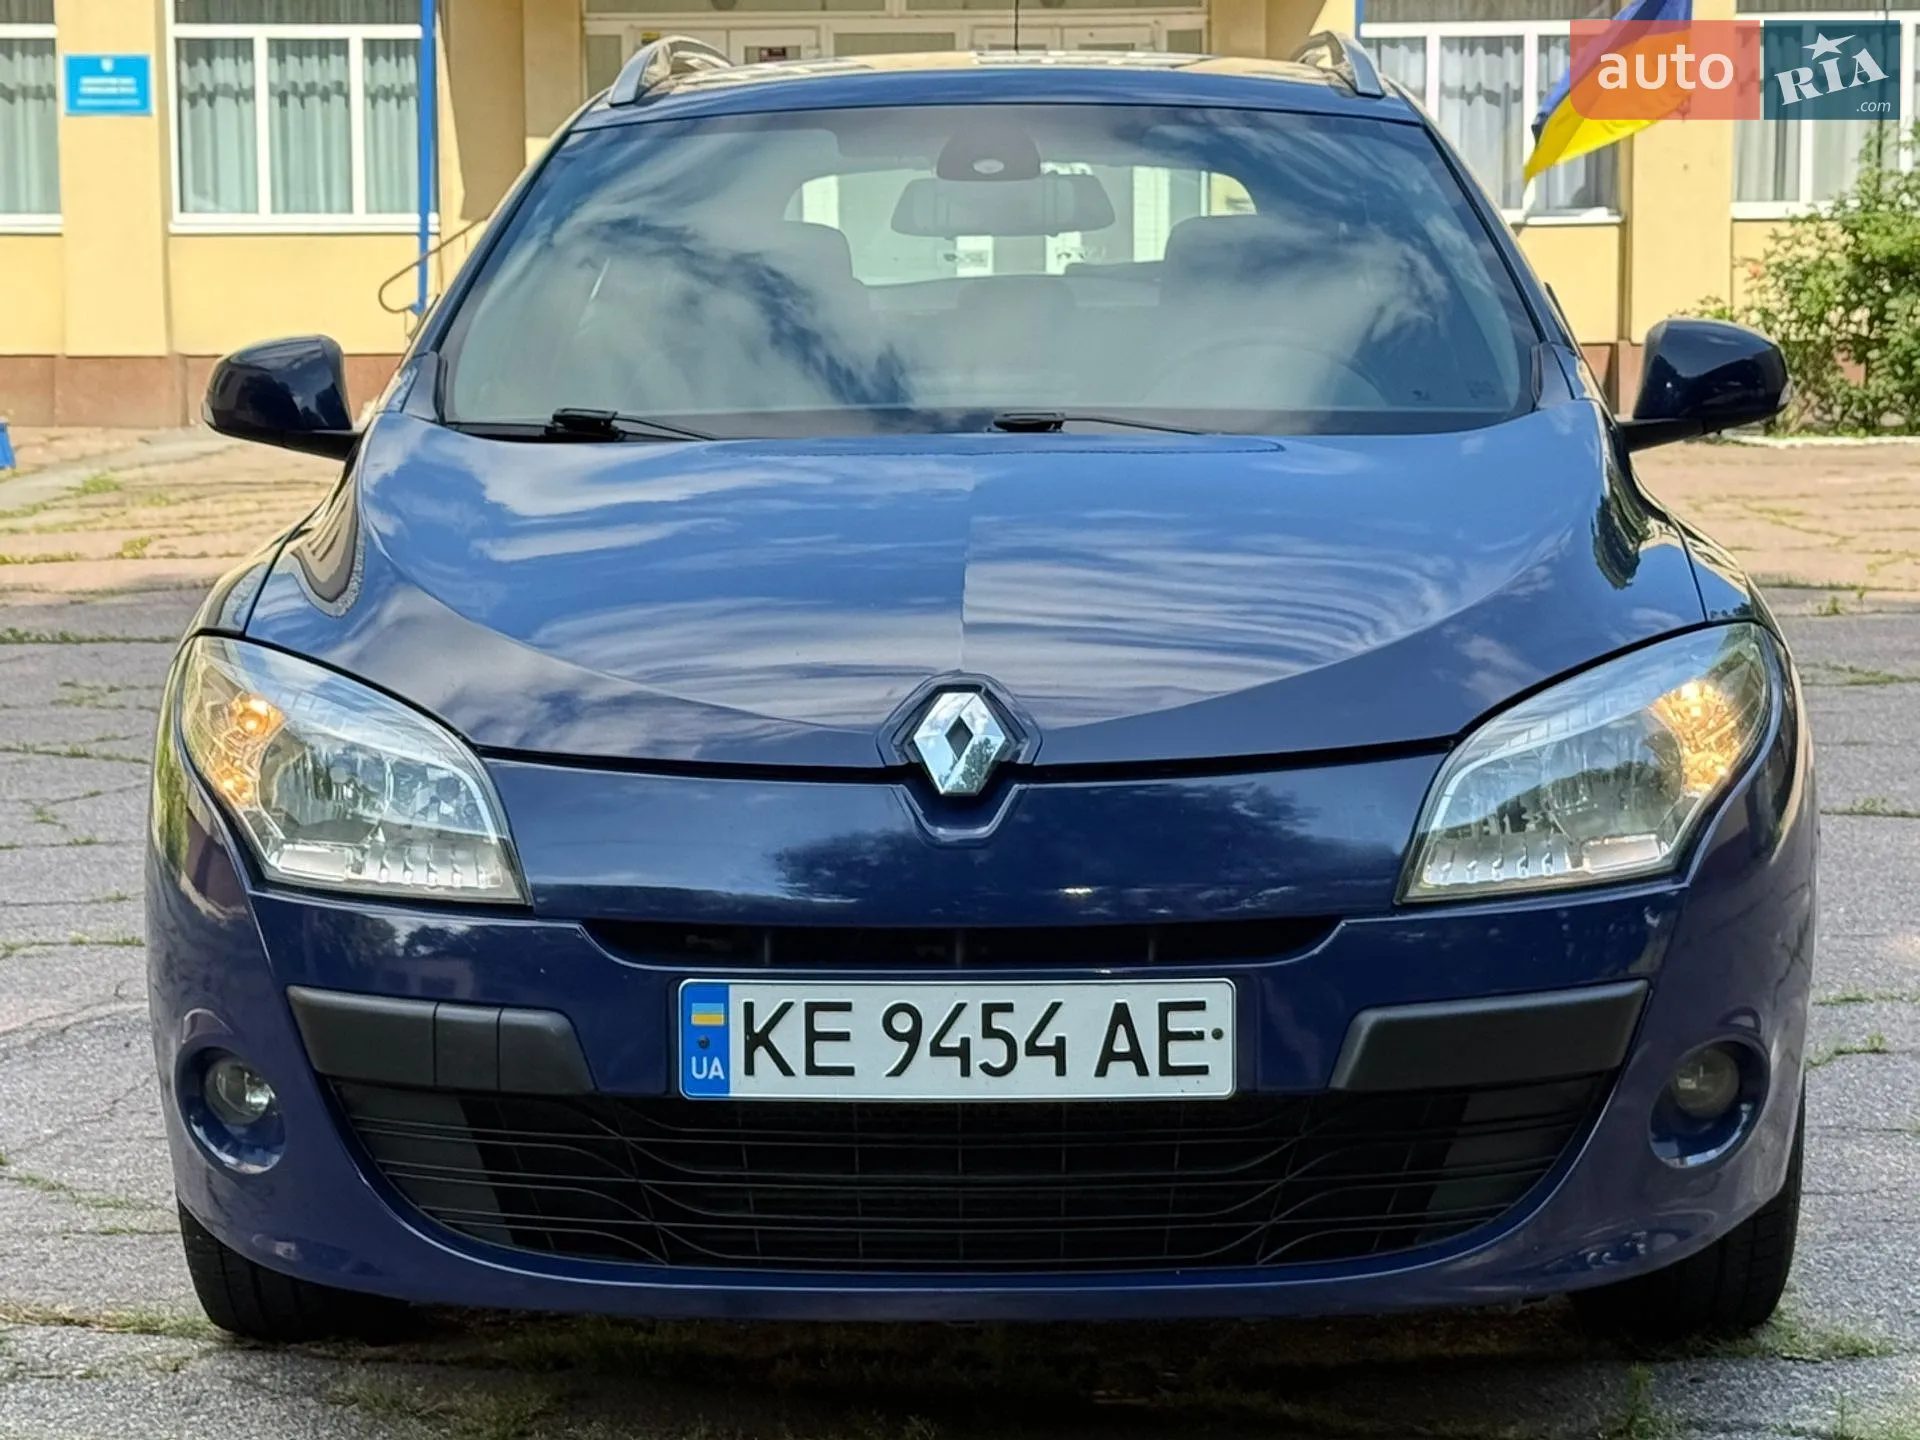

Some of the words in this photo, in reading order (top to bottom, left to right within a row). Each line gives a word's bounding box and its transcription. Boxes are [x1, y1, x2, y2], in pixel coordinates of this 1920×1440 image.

[743, 1001, 855, 1076] KE
[881, 1001, 1066, 1077] 9454
[1094, 1001, 1209, 1076] AE
[691, 1056, 724, 1079] UA
